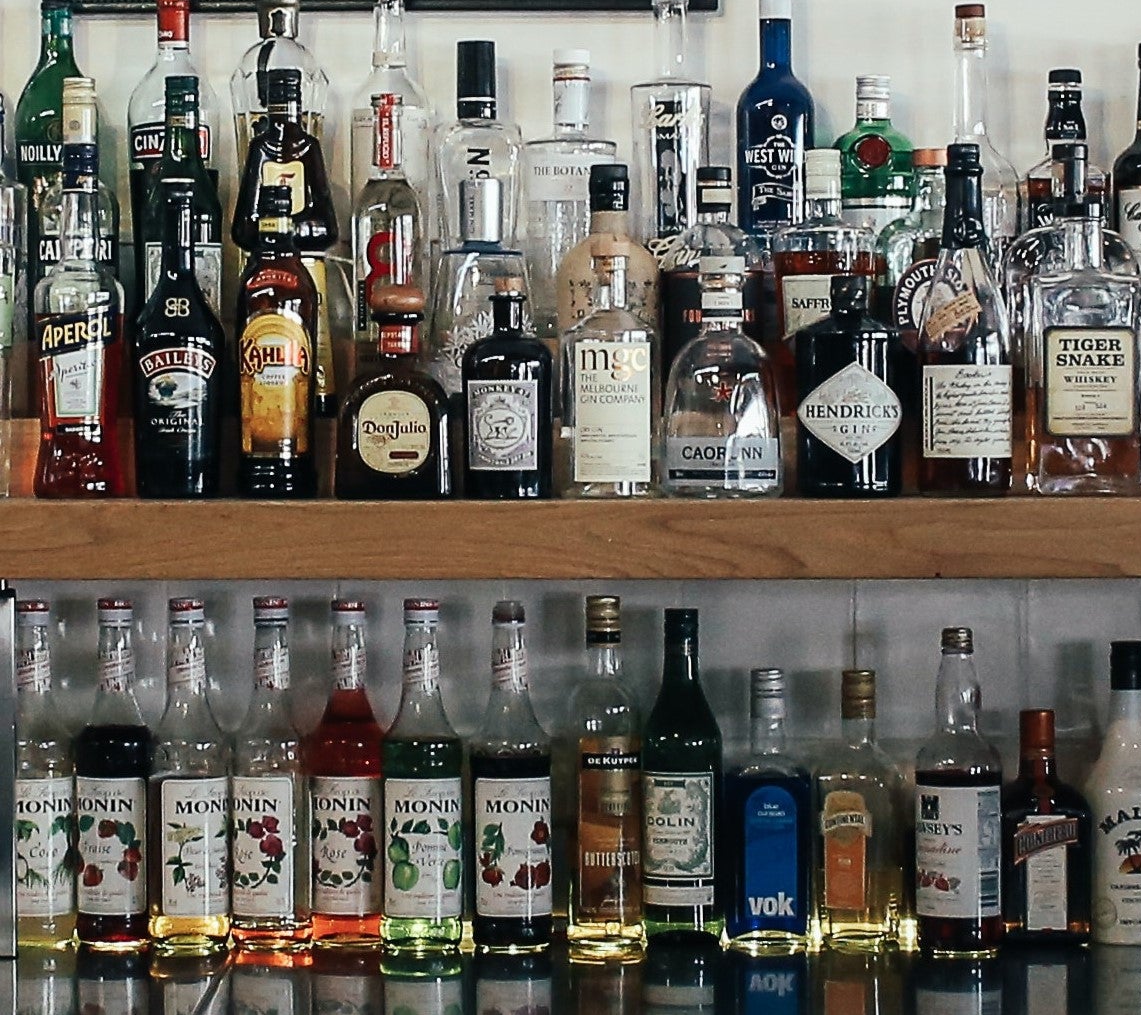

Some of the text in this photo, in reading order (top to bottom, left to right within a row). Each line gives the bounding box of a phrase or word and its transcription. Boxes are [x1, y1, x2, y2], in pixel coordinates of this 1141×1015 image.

[21, 145, 62, 162] NOILLY
[745, 149, 774, 163] WEST
[534, 166, 591, 176] THE BOTAN
[42, 317, 112, 351] APEROL
[1059, 338, 1121, 351] TIGER
[239, 338, 310, 375] KAHLA
[1056, 353, 1125, 366] SNAKE
[581, 348, 647, 381] mgc
[580, 373, 598, 383] THE
[1064, 375, 1117, 384] WHISKEY
[580, 384, 639, 394] MELBOURNE
[580, 395, 645, 404] GIN COMPANY
[805, 403, 900, 420] HENDRICK'S
[682, 446, 763, 460] CAORNN
[395, 799, 461, 814] MONIN
[485, 799, 550, 814] MONIN
[648, 816, 695, 827] DOLIN
[748, 892, 794, 916] vok
